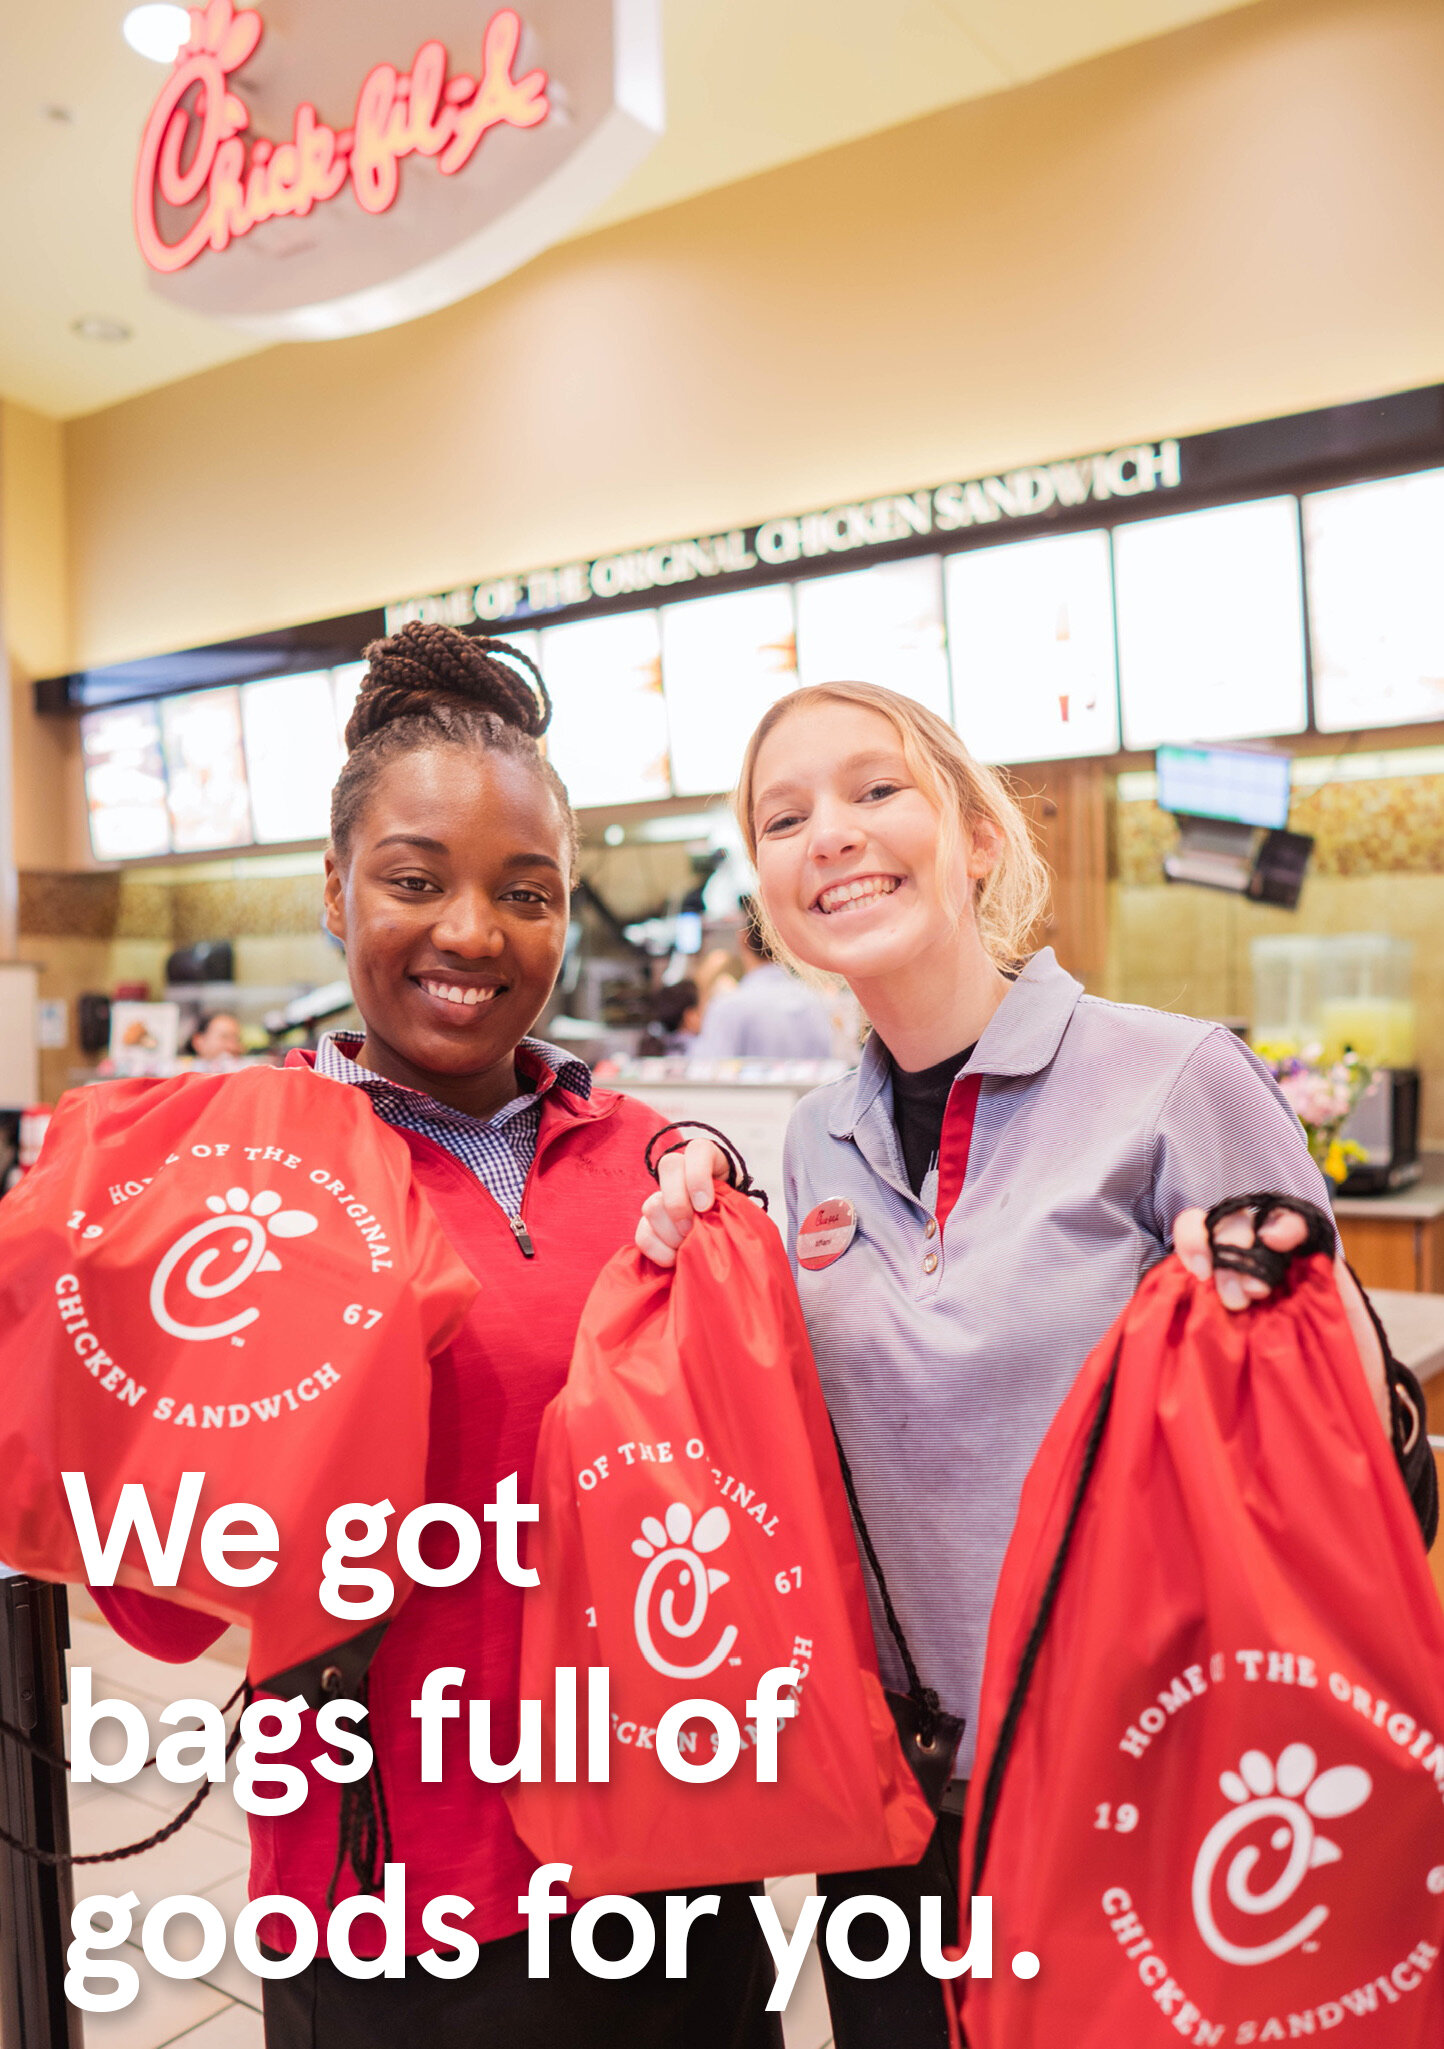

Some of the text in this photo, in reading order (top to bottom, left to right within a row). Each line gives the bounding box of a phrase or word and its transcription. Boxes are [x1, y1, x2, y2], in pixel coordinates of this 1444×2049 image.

[474, 578, 524, 621] OF
[527, 561, 593, 611] THE
[590, 530, 759, 598] ORIGINAL
[755, 494, 932, 565] CHICKEN
[934, 438, 1181, 532] SANDWICH
[66, 1210, 104, 1239] 19
[108, 1144, 394, 1273] HO OF THE ORIGINAL
[54, 1273, 342, 1429] CHICKEN SANDWICH
[342, 1303, 384, 1330] 67
[578, 1438, 780, 1537] OF THE OINAL
[774, 1566, 803, 1594] 67
[1118, 1649, 1444, 1803] HOME THE ORIGIN
[1094, 1802, 1140, 1833] 19
[1101, 1886, 1438, 2047] CHICKEN SANDWICH
